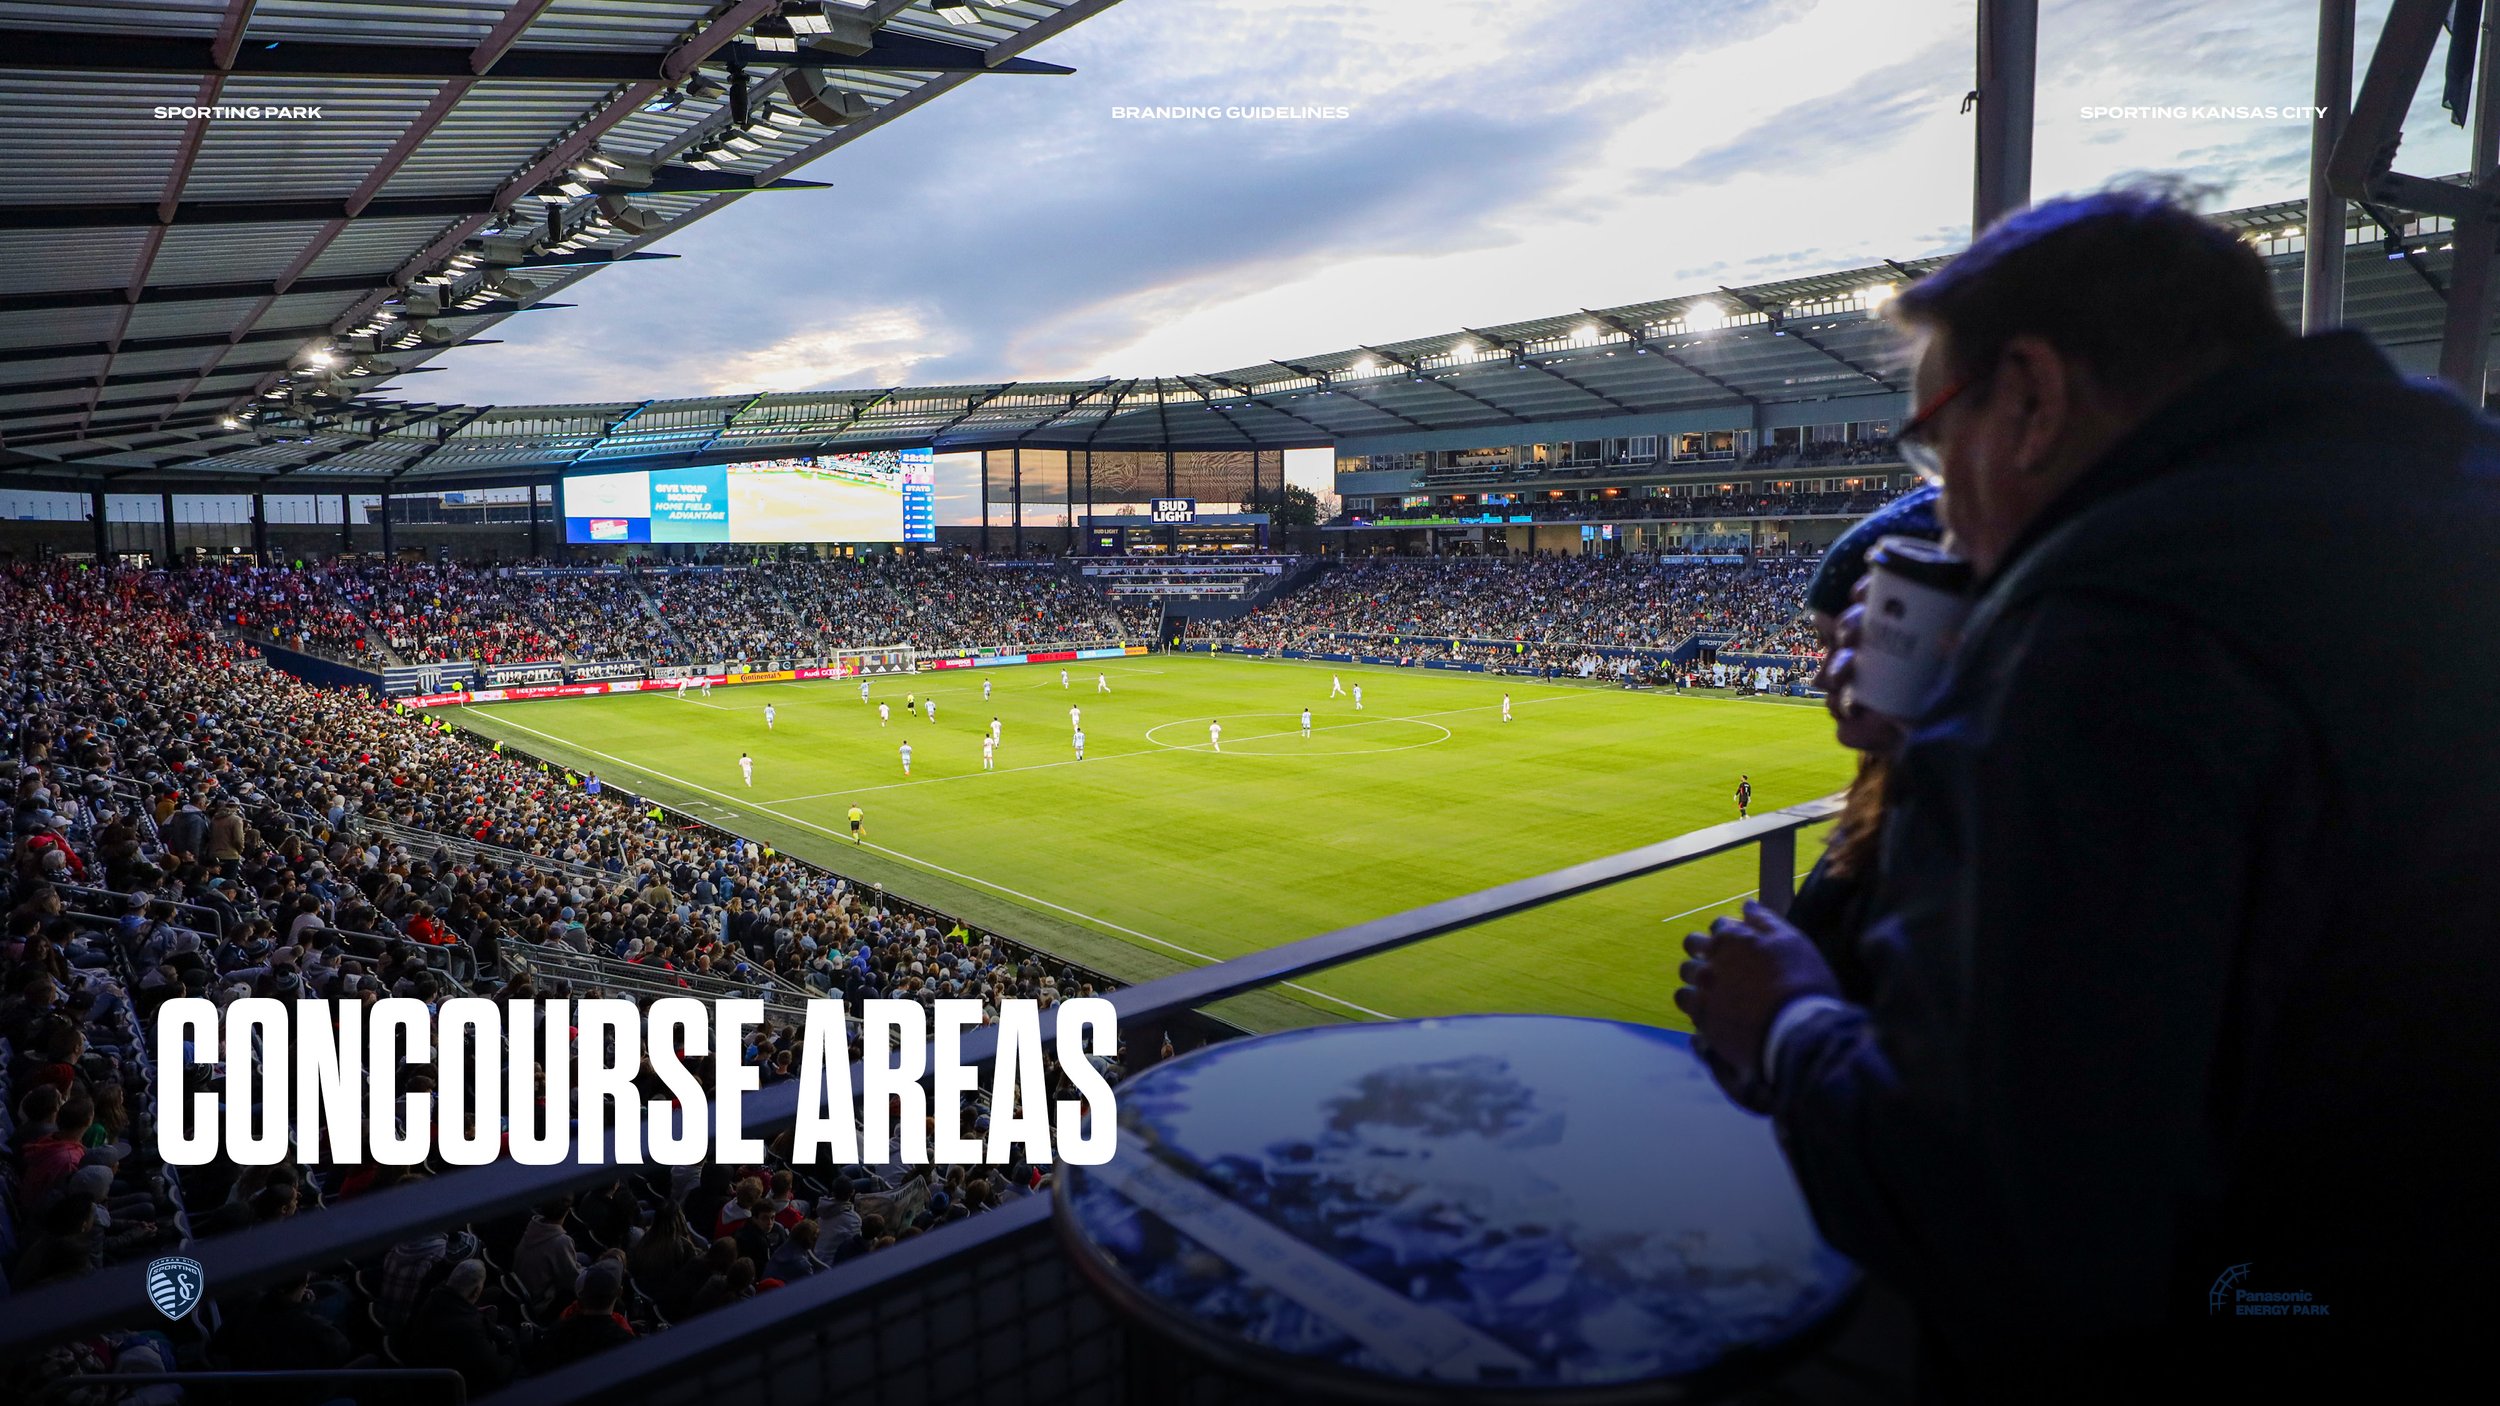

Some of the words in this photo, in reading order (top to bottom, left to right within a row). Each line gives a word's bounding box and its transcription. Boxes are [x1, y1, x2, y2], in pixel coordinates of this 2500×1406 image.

[680, 484, 708, 494] YOUR
[655, 503, 684, 511] HOME
[684, 503, 712, 511] FIELD
[1158, 501, 1188, 512] BUD
[668, 511, 725, 520] ADVANTAGE
[1153, 511, 1194, 522] LIGHT
[740, 673, 777, 682] Continental
